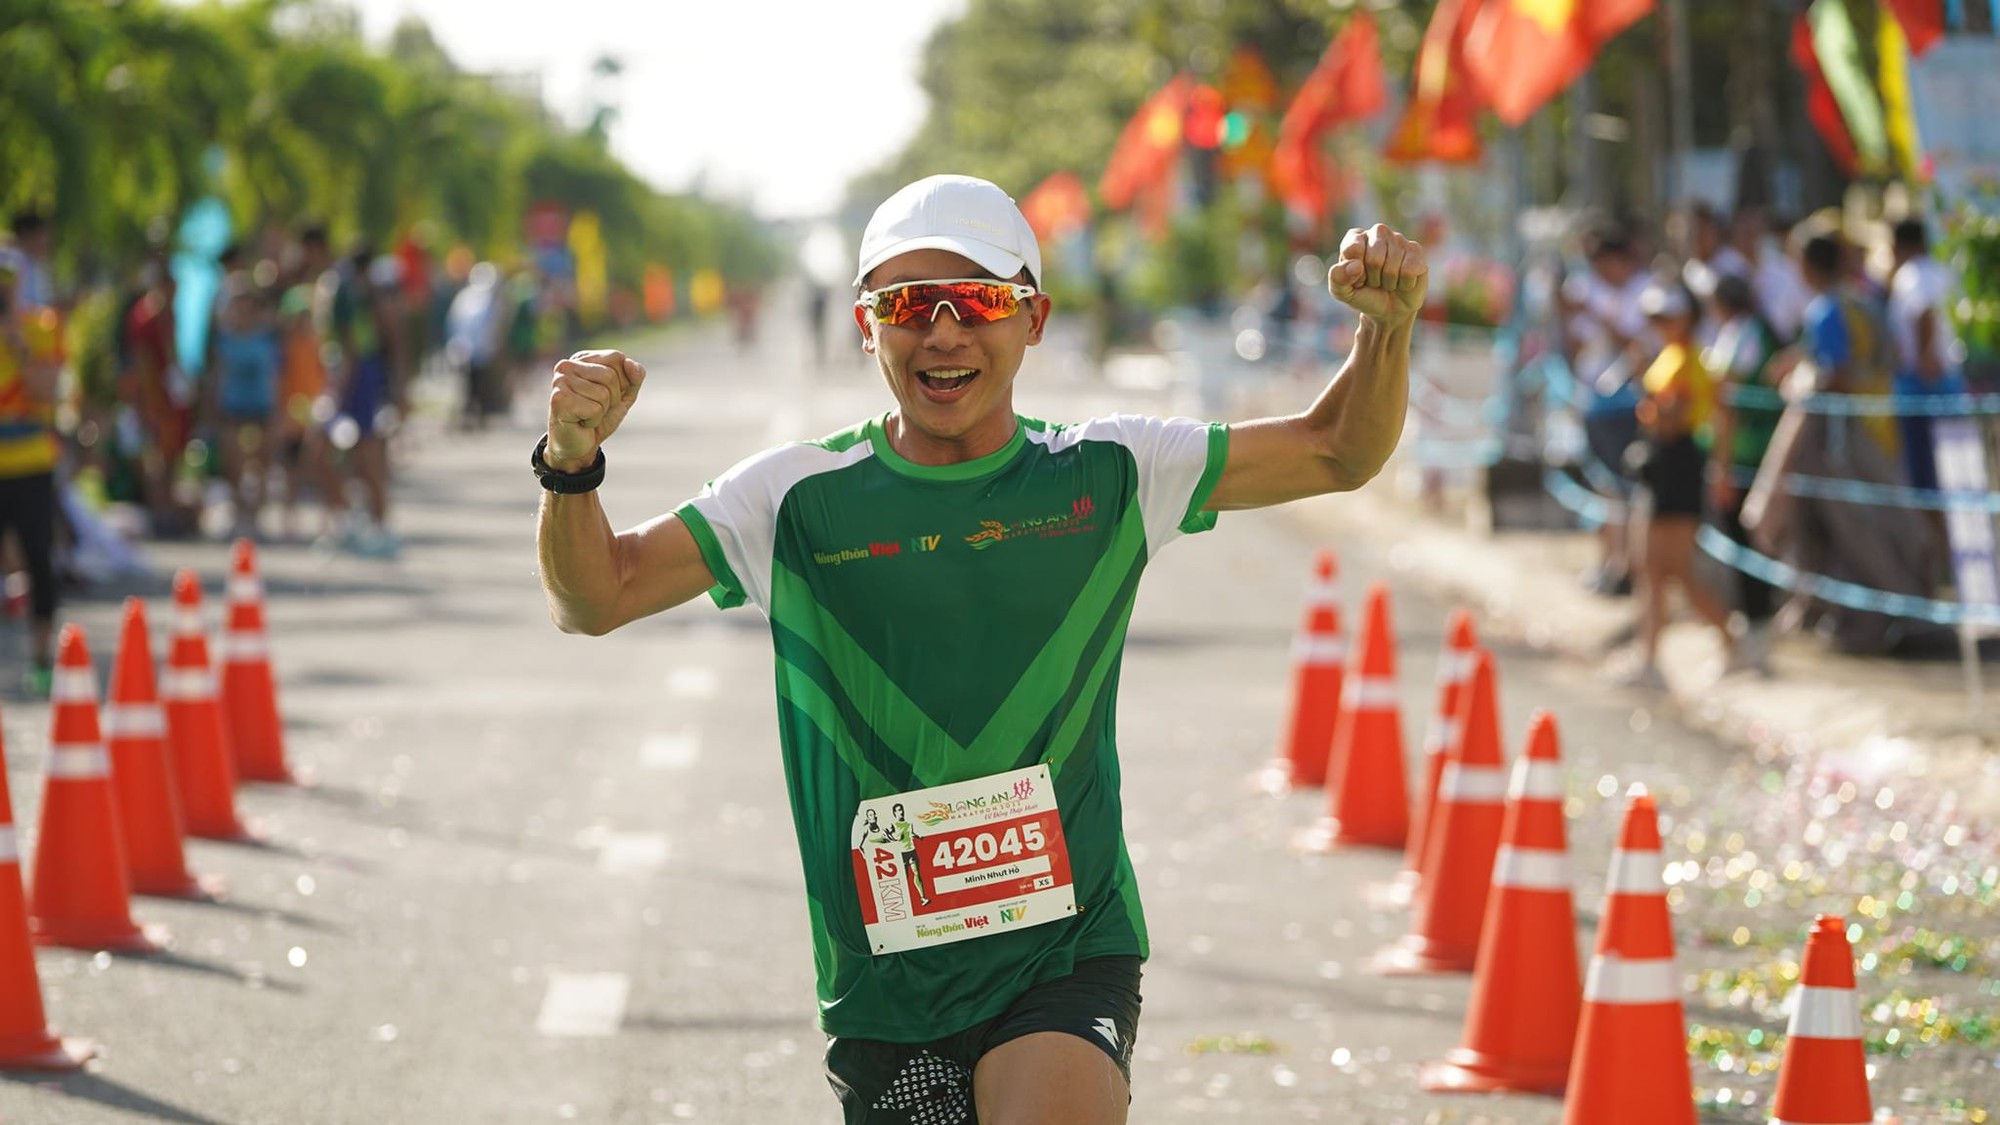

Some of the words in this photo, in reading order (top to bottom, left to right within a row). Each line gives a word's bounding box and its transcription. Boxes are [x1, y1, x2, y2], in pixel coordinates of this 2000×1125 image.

[948, 797, 986, 812] LONG
[990, 791, 1010, 804] AN
[951, 806, 998, 819] MARATHON
[932, 822, 1046, 870] 42045
[964, 873, 986, 885] Minh
[1039, 879, 1050, 887] XS
[964, 915, 990, 929] Việt
[1000, 906, 1028, 924] NTV
